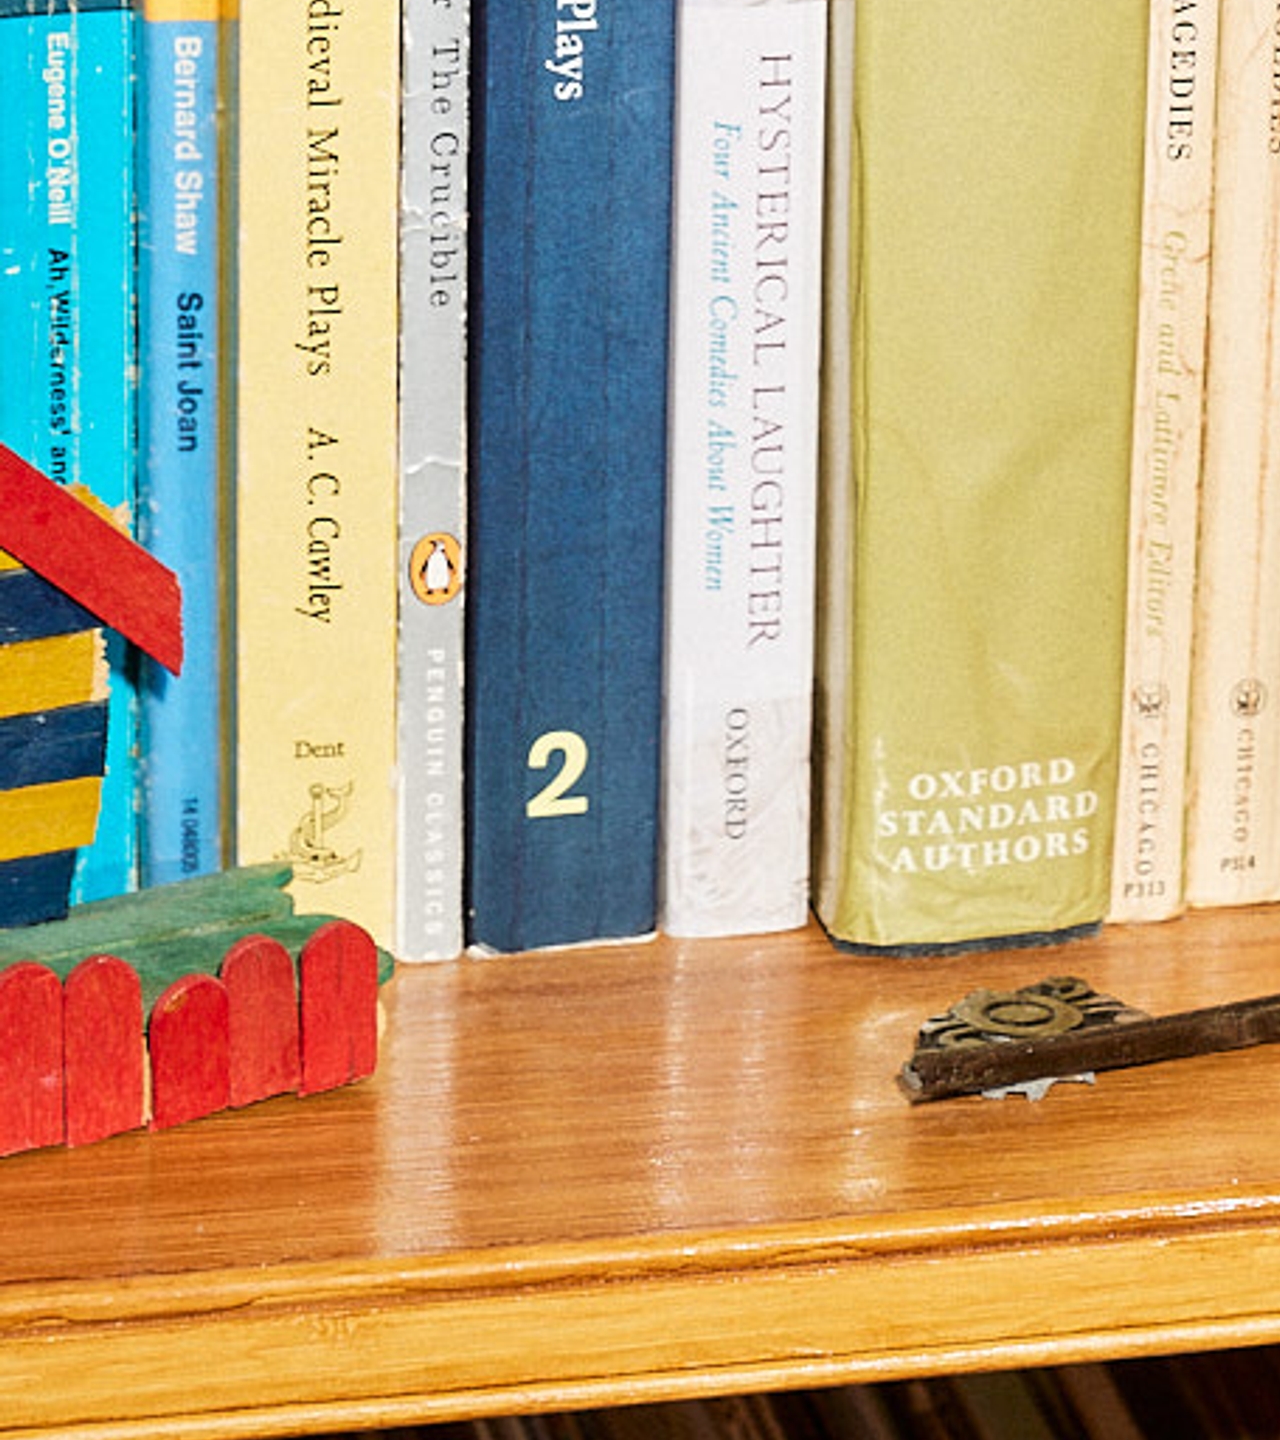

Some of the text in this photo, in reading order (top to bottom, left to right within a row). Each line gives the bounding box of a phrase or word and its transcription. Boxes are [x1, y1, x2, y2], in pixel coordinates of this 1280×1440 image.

[41, 32, 71, 224] Eugene O'Neill
[432, 38, 460, 114] The
[173, 36, 203, 452] Bernard Shaw Saint Joan
[306, 129, 340, 267] Miracle
[429, 133, 460, 308] Crucible
[296, 285, 339, 376] Plays
[705, 122, 742, 591] Four Ancient Comedies About Women
[748, 54, 793, 647] HYSTERICAL LAUGHTER
[296, 427, 339, 624] A. C. Cawley
[1145, 324, 1185, 636] and Editors
[295, 742, 344, 758] Dent
[423, 648, 445, 935] PENGUIN CLASSICS
[526, 731, 588, 817] 2
[724, 709, 750, 840] OXFORD
[879, 790, 1099, 837] STANDARD
[909, 757, 1076, 801] OXFORD
[1138, 742, 1160, 875] CHICAGO
[1233, 728, 1254, 843] CHICAGO
[893, 829, 1090, 874] AUTHORS
